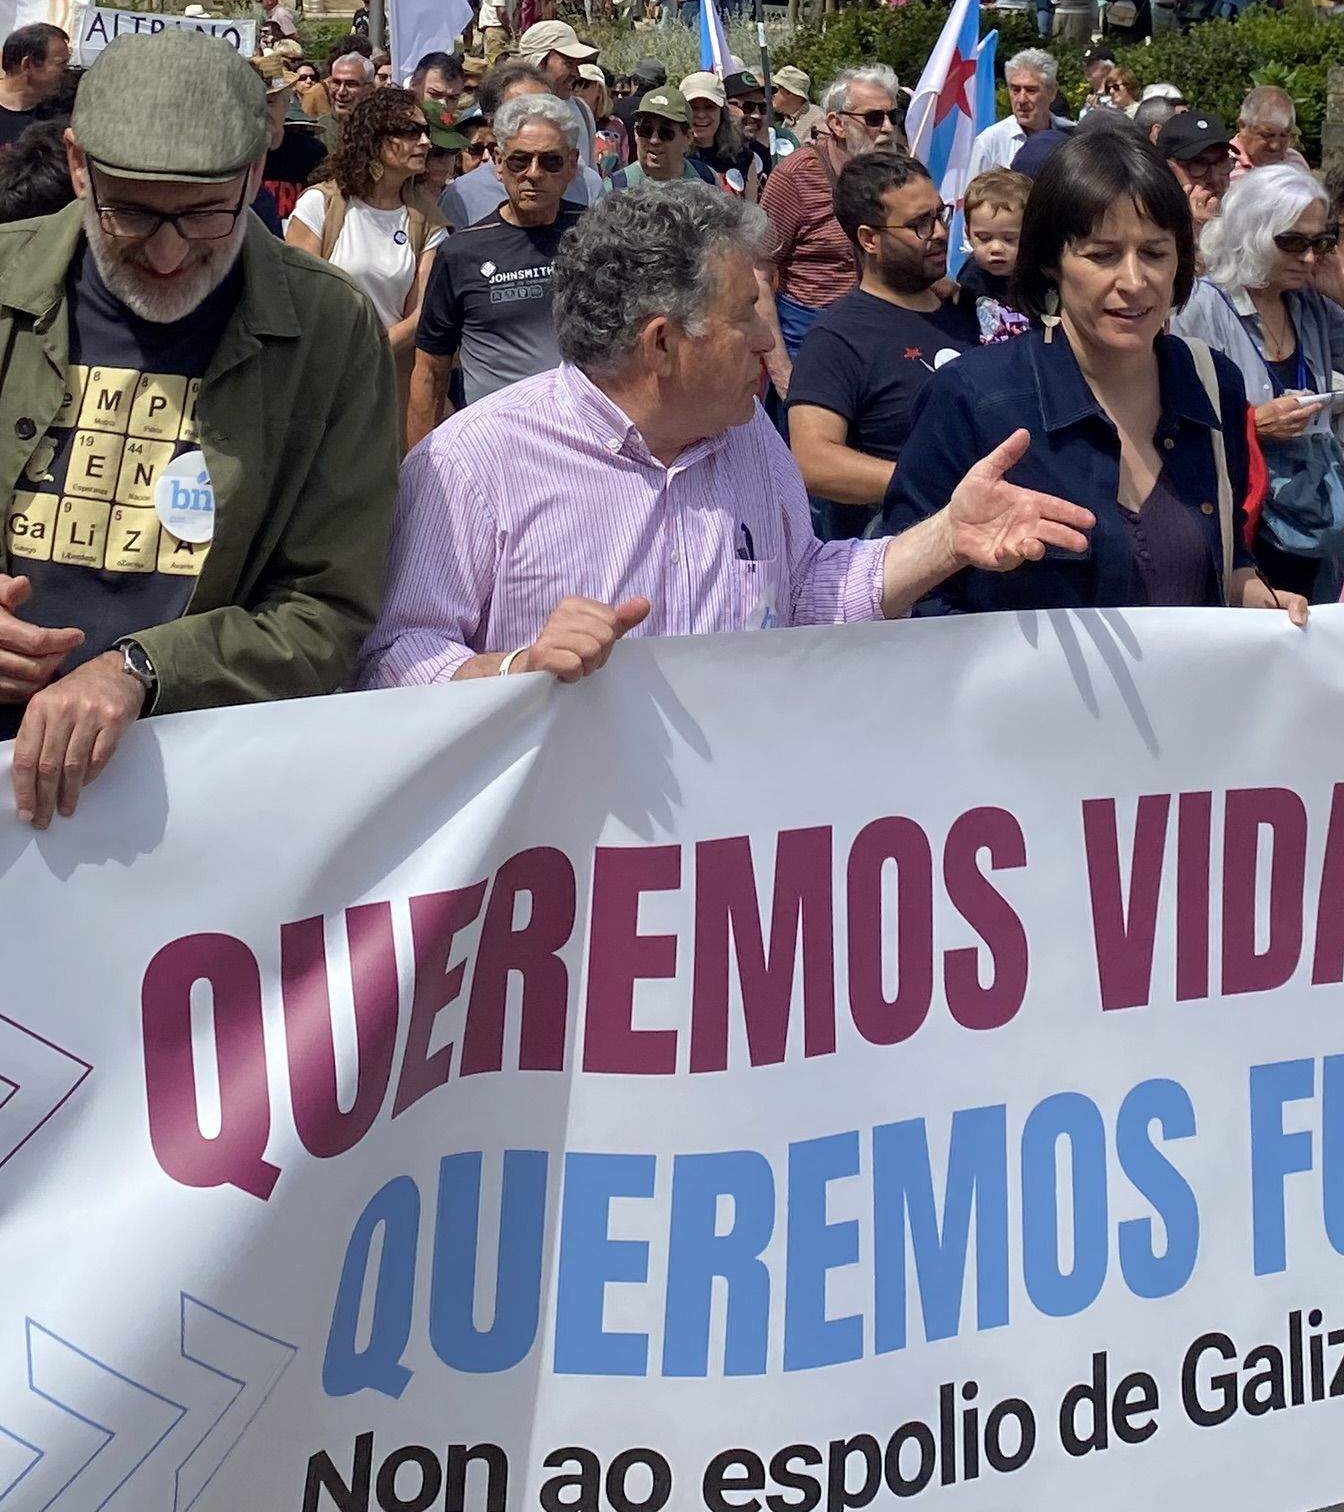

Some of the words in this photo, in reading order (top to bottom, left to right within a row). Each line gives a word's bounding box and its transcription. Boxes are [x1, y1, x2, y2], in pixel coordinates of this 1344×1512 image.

[489, 266, 554, 284] JOHNSMITH
[93, 371, 101, 381] 8
[97, 389, 122, 411] M
[148, 395, 167, 417] P
[79, 435, 95, 447] 19
[127, 443, 143, 455] 44
[85, 455, 106, 478] E
[133, 462, 154, 486] N
[64, 501, 72, 513] 9
[171, 480, 213, 510] bn
[9, 512, 45, 539] Ga
[70, 521, 96, 546] Li
[122, 530, 141, 553] Z
[142, 807, 1027, 1199] QUEREMOS
[322, 1077, 1200, 1399] QUEREMOS
[301, 1430, 509, 1512] Non
[539, 1446, 672, 1512] ao
[702, 1381, 1037, 1512] espolio
[1059, 1350, 1159, 1457] de
